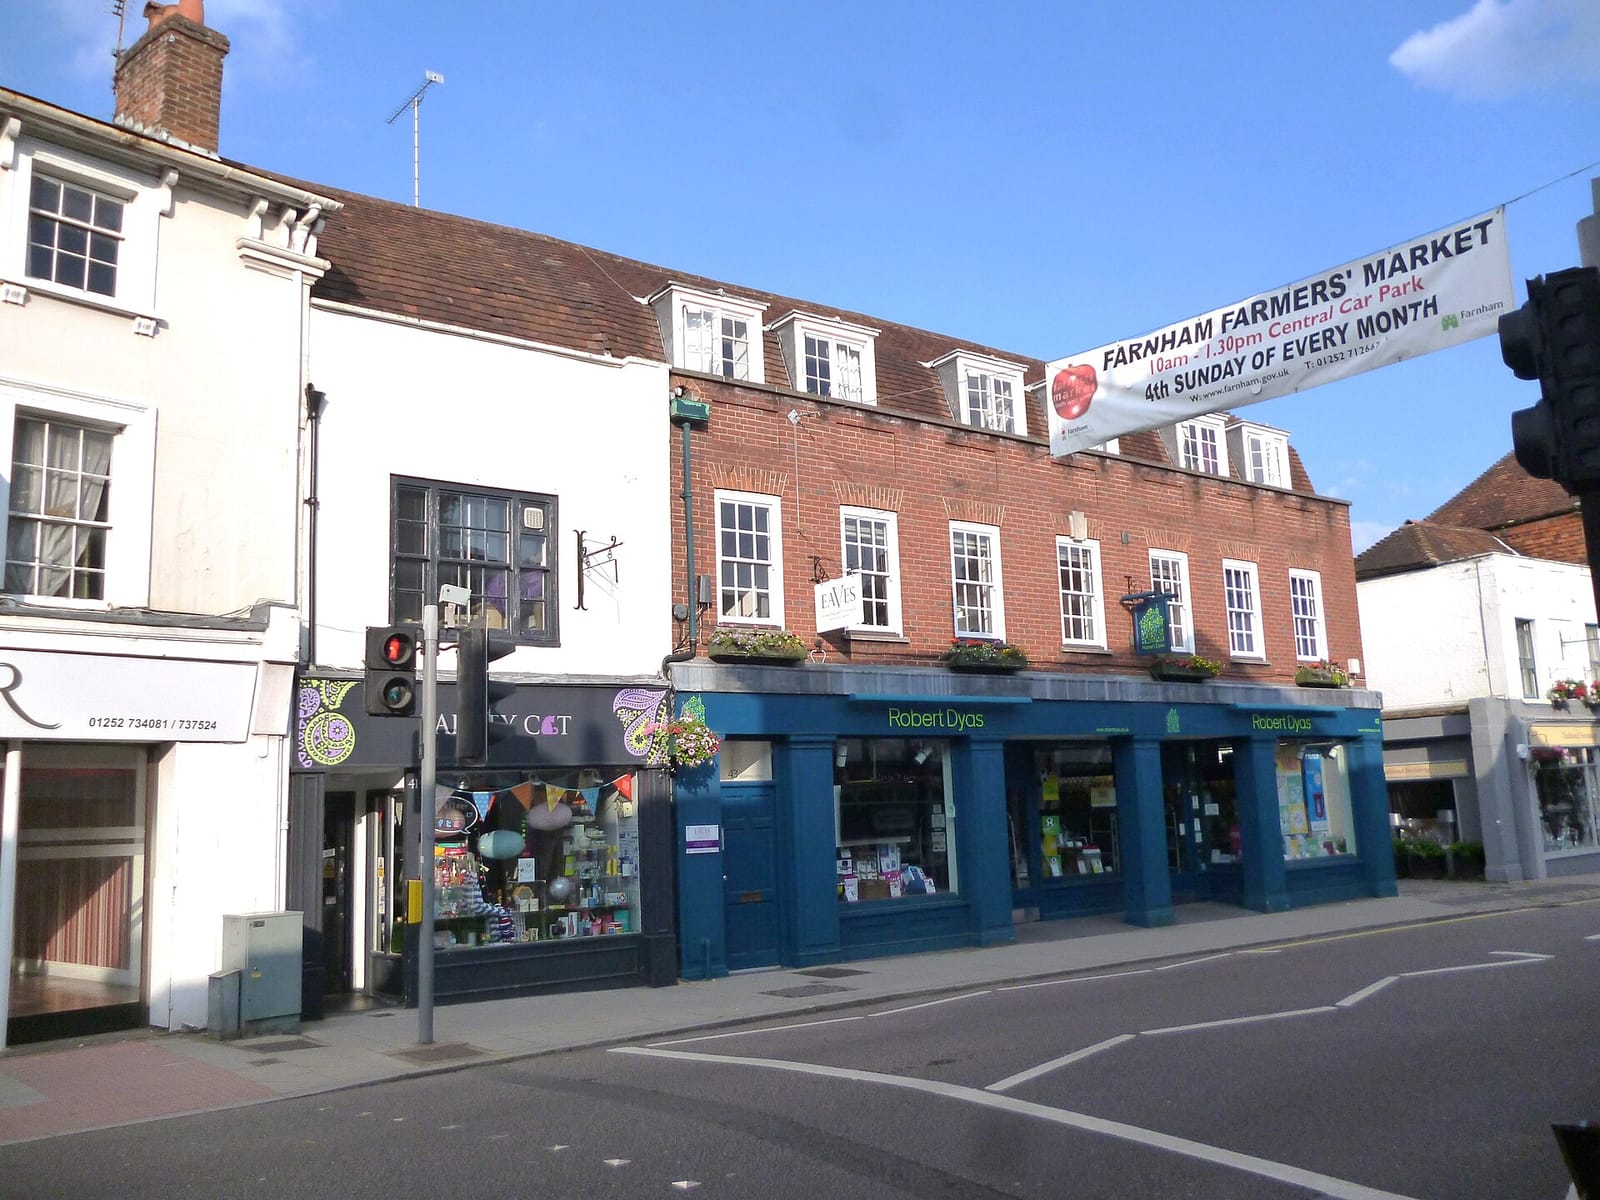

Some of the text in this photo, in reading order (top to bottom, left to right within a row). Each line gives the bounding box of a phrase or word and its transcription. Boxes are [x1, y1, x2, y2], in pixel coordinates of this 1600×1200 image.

[1102, 218, 1493, 372] FARNHAM FARMERS' MARKET
[1460, 300, 1504, 319] Farnham
[1150, 353, 1188, 375] 10am
[1205, 331, 1263, 360] 1.30pm
[1268, 305, 1334, 339] Central
[1339, 293, 1373, 315] Car
[1378, 275, 1425, 302] Park
[1145, 294, 1439, 402] 4th SUNDAY OF EVERY MONTH
[1203, 368, 1290, 400] www.farnham.gov.uk
[1316, 352, 1345, 367] 01252
[88, 717, 125, 728] 01252
[128, 718, 168, 729] 734081
[178, 719, 217, 730] 737524
[888, 708, 984, 732] Robert Dyas
[1252, 714, 1312, 733] Robert Dyas
